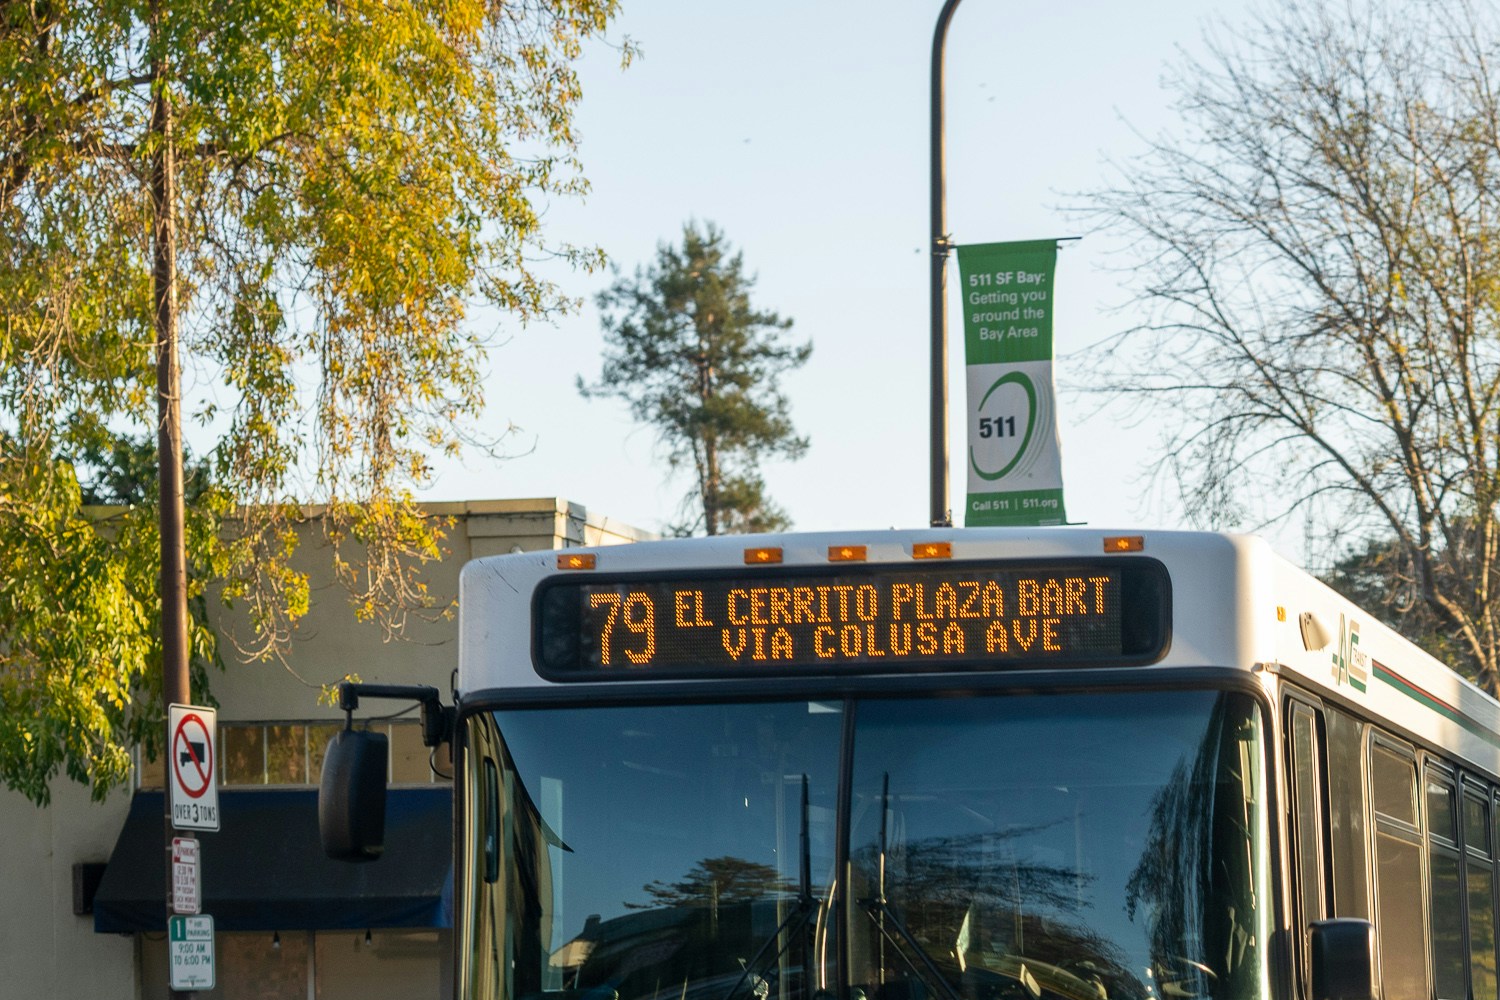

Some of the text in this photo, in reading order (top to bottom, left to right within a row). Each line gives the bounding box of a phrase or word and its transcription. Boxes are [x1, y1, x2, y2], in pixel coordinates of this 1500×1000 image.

[969, 274, 992, 287] 511
[996, 272, 1013, 285] SF
[969, 291, 1047, 305] Getting you
[972, 307, 1045, 323] around the
[979, 326, 1038, 342] Bay Area
[979, 415, 1016, 438] 511
[972, 498, 1058, 511] Call 511 511.org
[675, 576, 1110, 627] EL CERRITO PLAZA BART
[590, 592, 655, 665] 79
[722, 618, 1061, 661] VIA COLUSA AVE
[174, 803, 216, 823] OVER 3 TONS
[176, 920, 181, 938] 1
[179, 944, 205, 954] 9:00 AM
[174, 955, 210, 965] TO 6:00 PM
